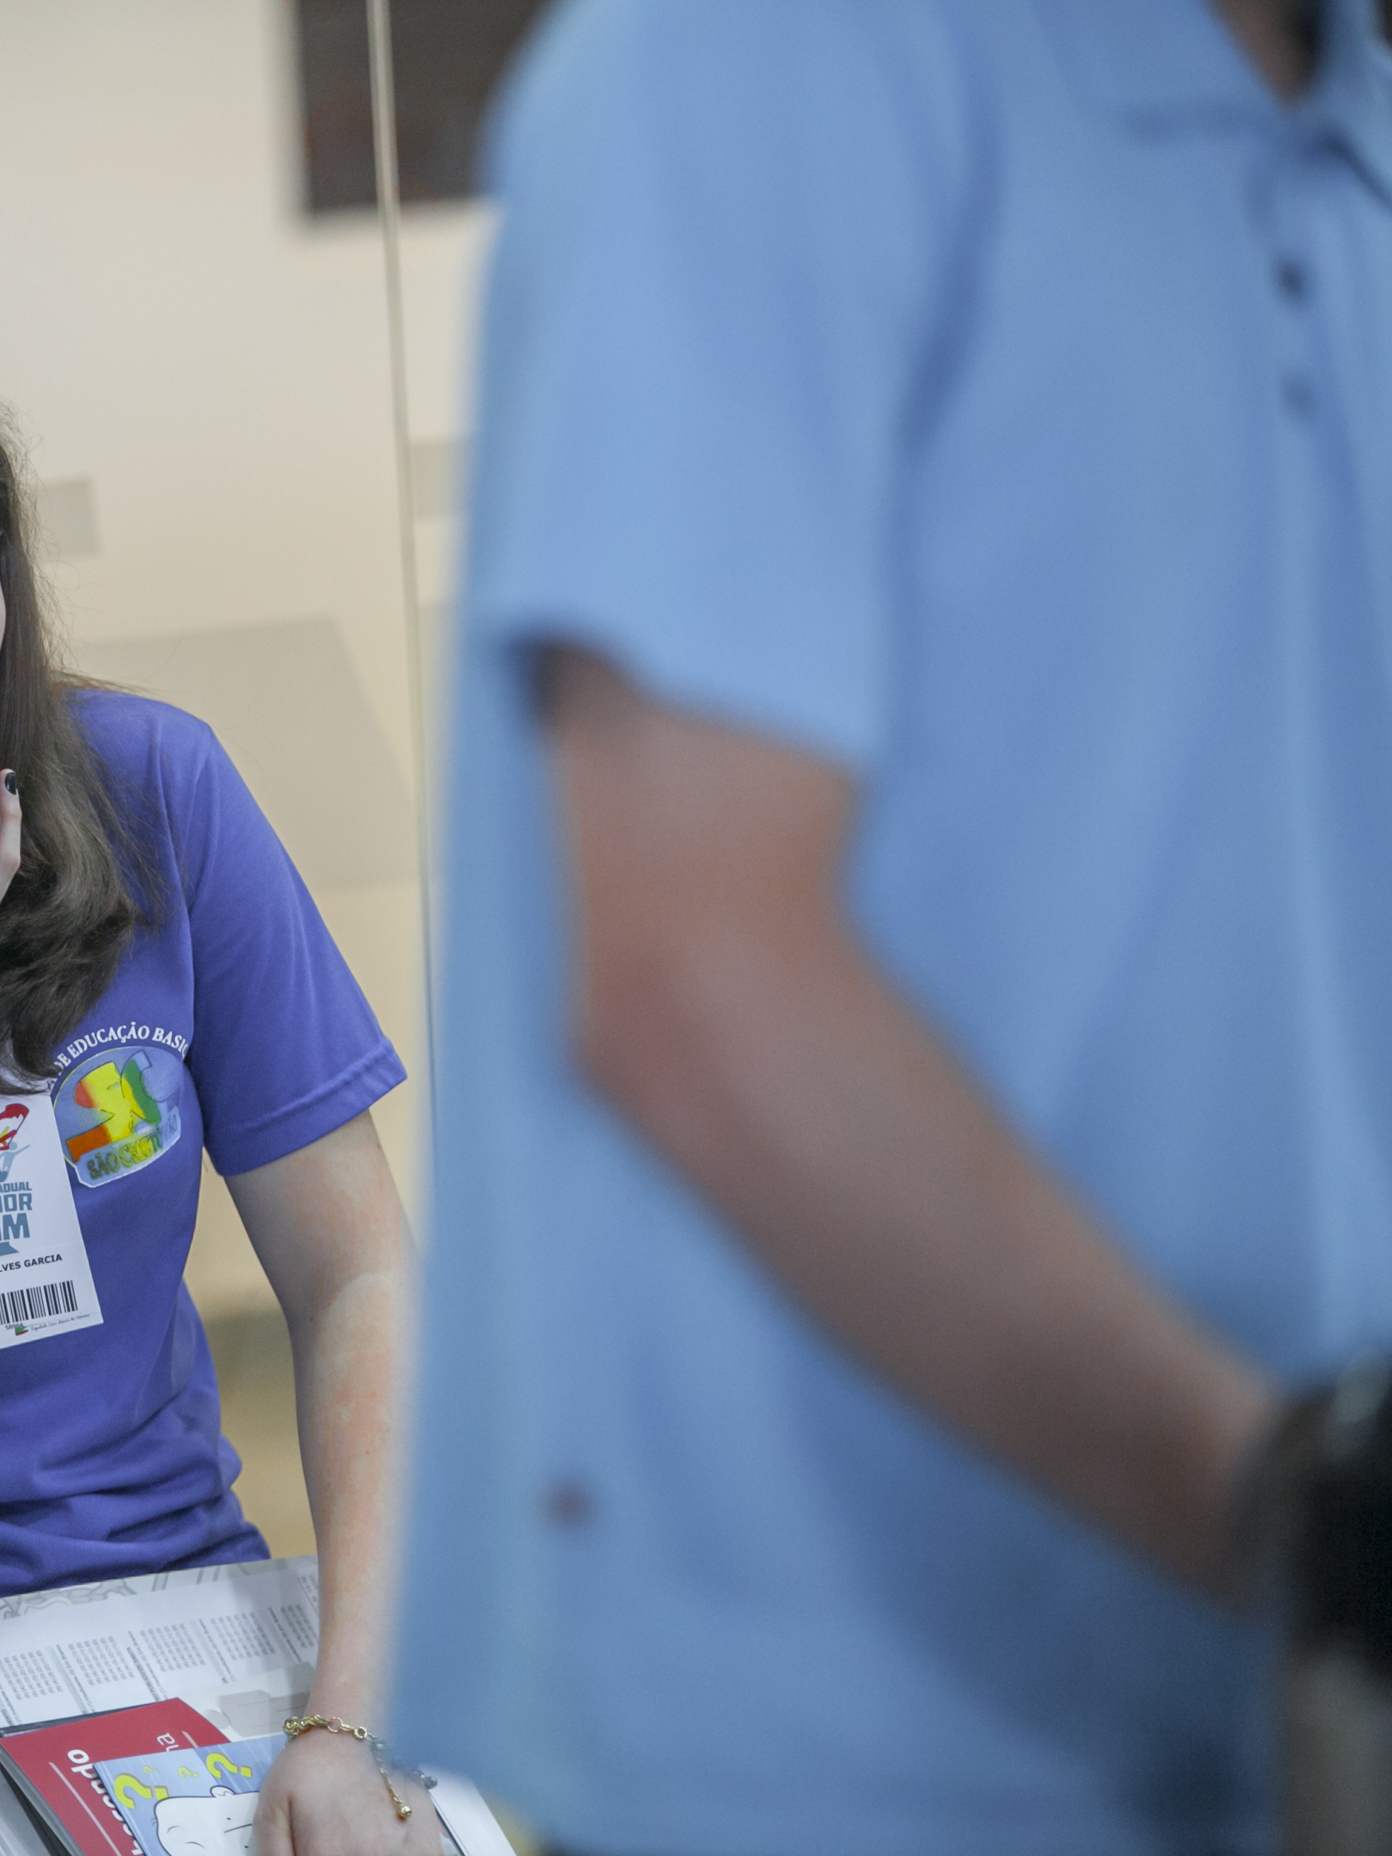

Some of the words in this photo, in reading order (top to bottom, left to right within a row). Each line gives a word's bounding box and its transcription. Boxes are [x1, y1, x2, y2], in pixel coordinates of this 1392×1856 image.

[67, 1022, 150, 1058] EDUCAÇÃO
[152, 1027, 188, 1058] BASIC
[87, 1152, 120, 1180] SÃO
[24, 1254, 62, 1267] GARCIA
